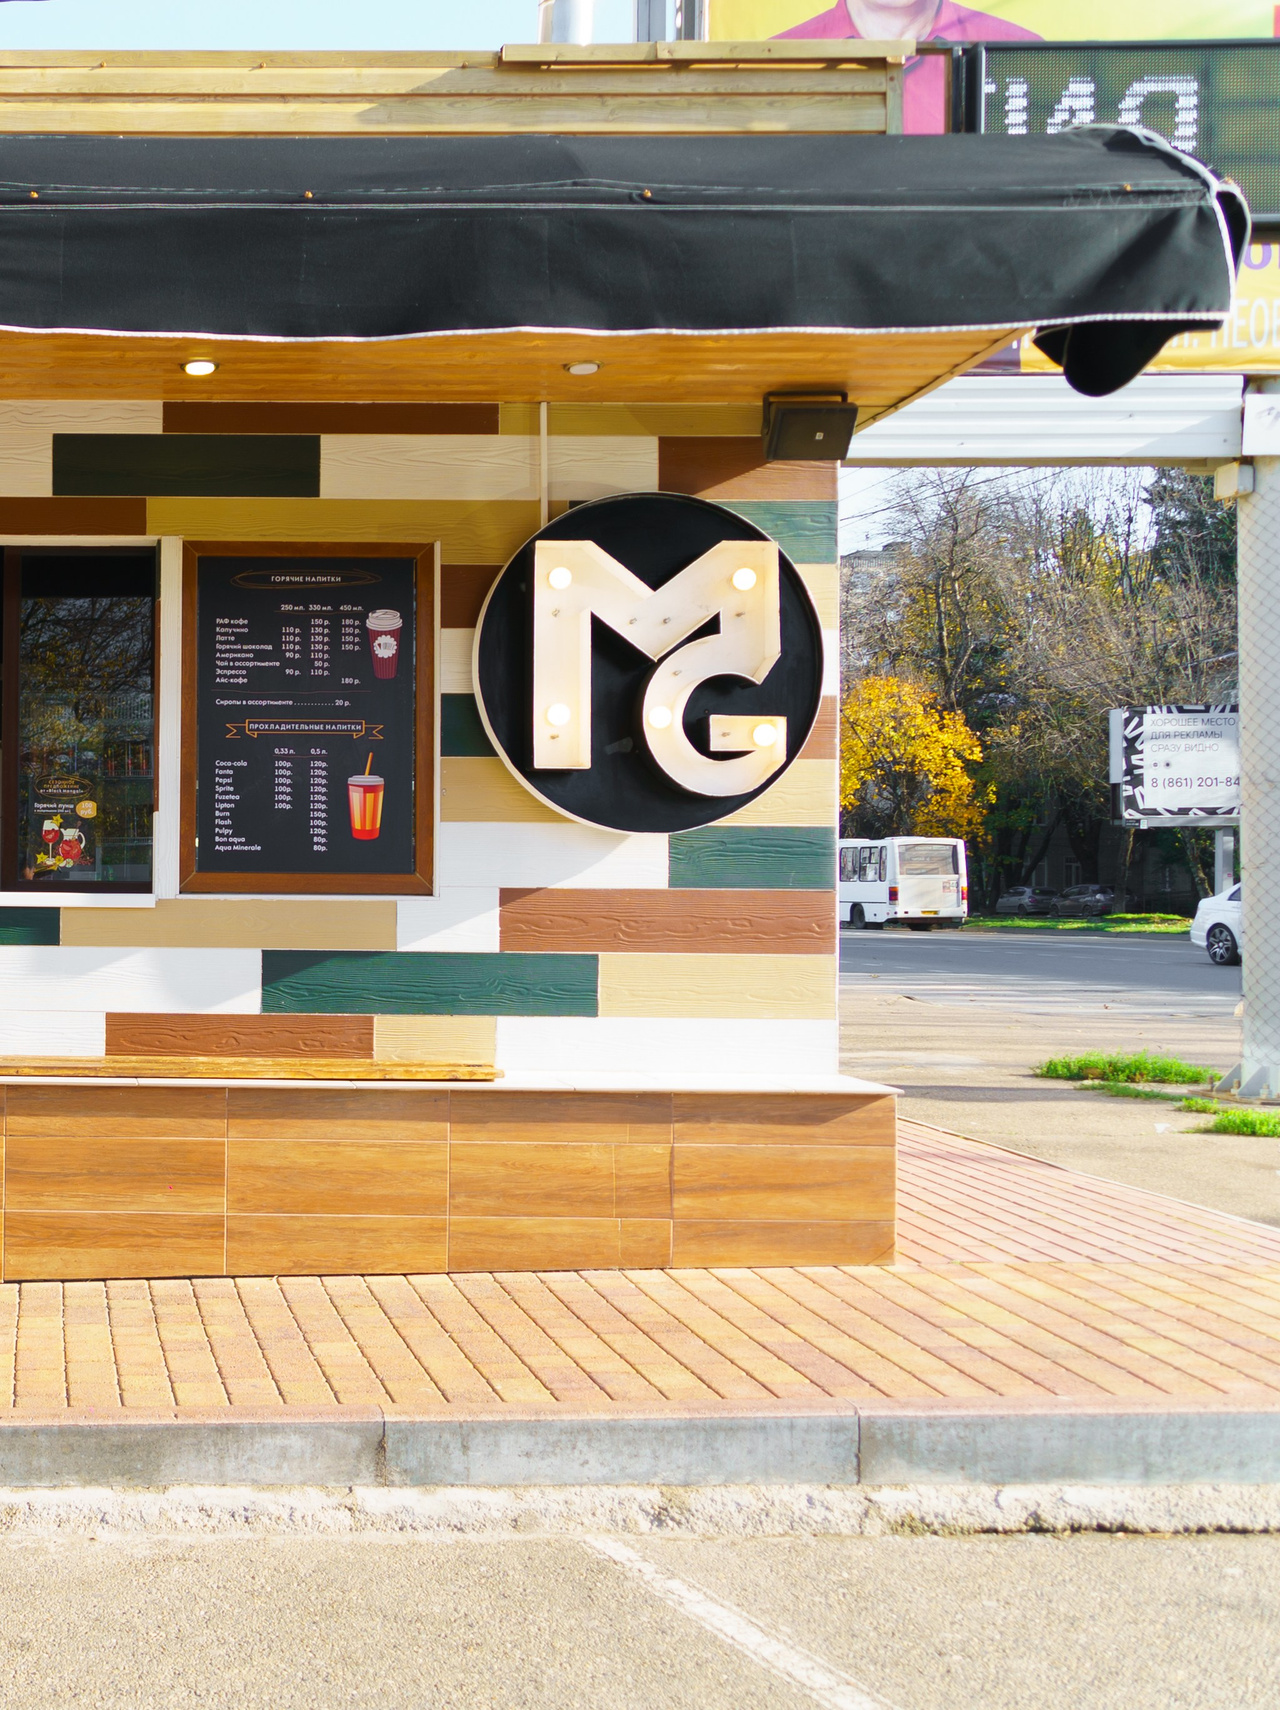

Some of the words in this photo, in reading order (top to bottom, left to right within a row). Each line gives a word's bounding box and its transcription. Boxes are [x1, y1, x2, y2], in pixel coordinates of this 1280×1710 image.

[533, 539, 788, 796] MG
[1150, 731, 1170, 739] ДЛЯ
[1151, 744, 1181, 752] СРАЗУ
[1184, 743, 1219, 752] ВИДНО
[1151, 778, 1158, 787] 8
[1163, 777, 1193, 789] (861)
